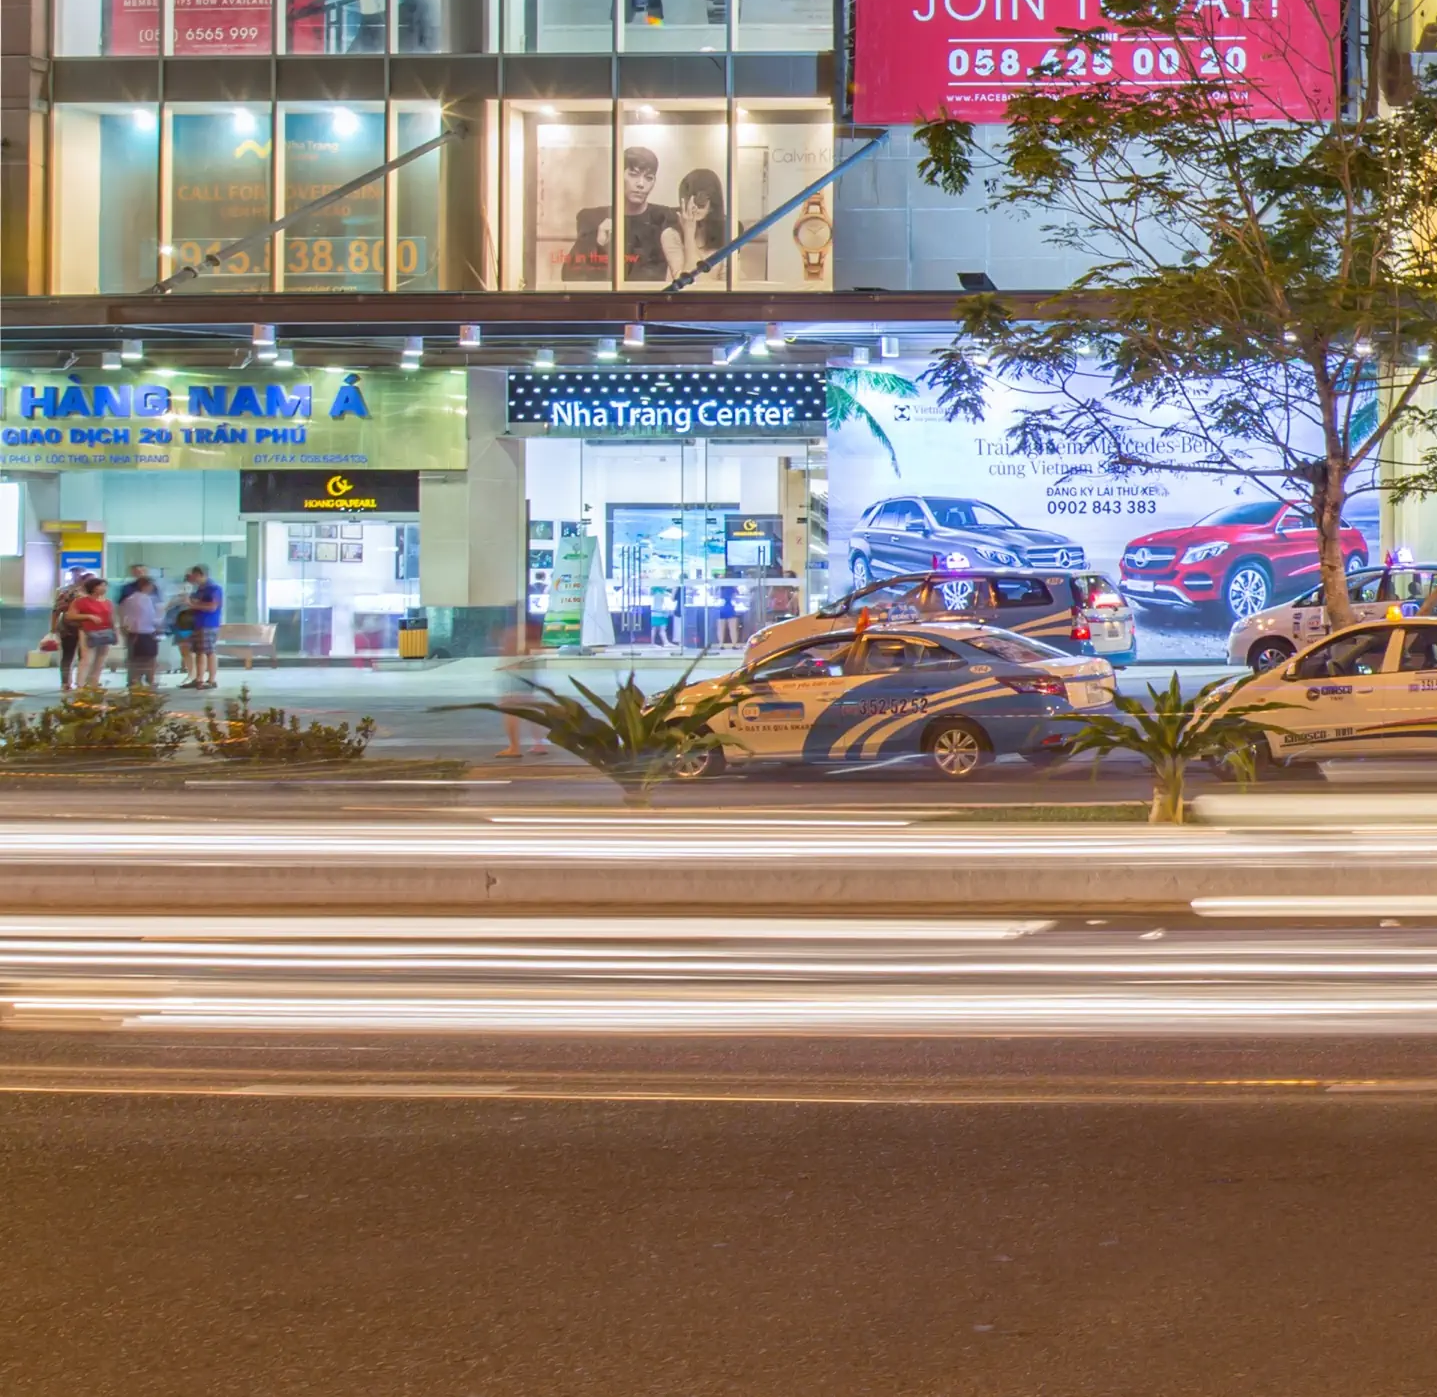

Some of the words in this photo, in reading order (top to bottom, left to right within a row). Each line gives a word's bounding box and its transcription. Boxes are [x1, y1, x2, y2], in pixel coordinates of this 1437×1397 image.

[185, 27, 225, 41] 6565
[229, 27, 259, 41] 999
[1132, 47, 1180, 76] 00
[1202, 46, 1248, 75] 20
[18, 373, 173, 420] HÀNG
[187, 384, 313, 419] NAM
[328, 373, 372, 420] Á
[550, 400, 608, 427] Nha
[609, 400, 692, 433] Trang
[698, 401, 795, 427] Center
[1, 427, 62, 447] GIAO
[69, 427, 130, 449] DỊCH
[138, 428, 173, 446] 20
[255, 424, 307, 446] PHÚ
[134, 454, 170, 464] TRANG
[1046, 501, 1087, 514] 0902
[1092, 501, 1123, 514] 843
[1126, 500, 1157, 514] 383
